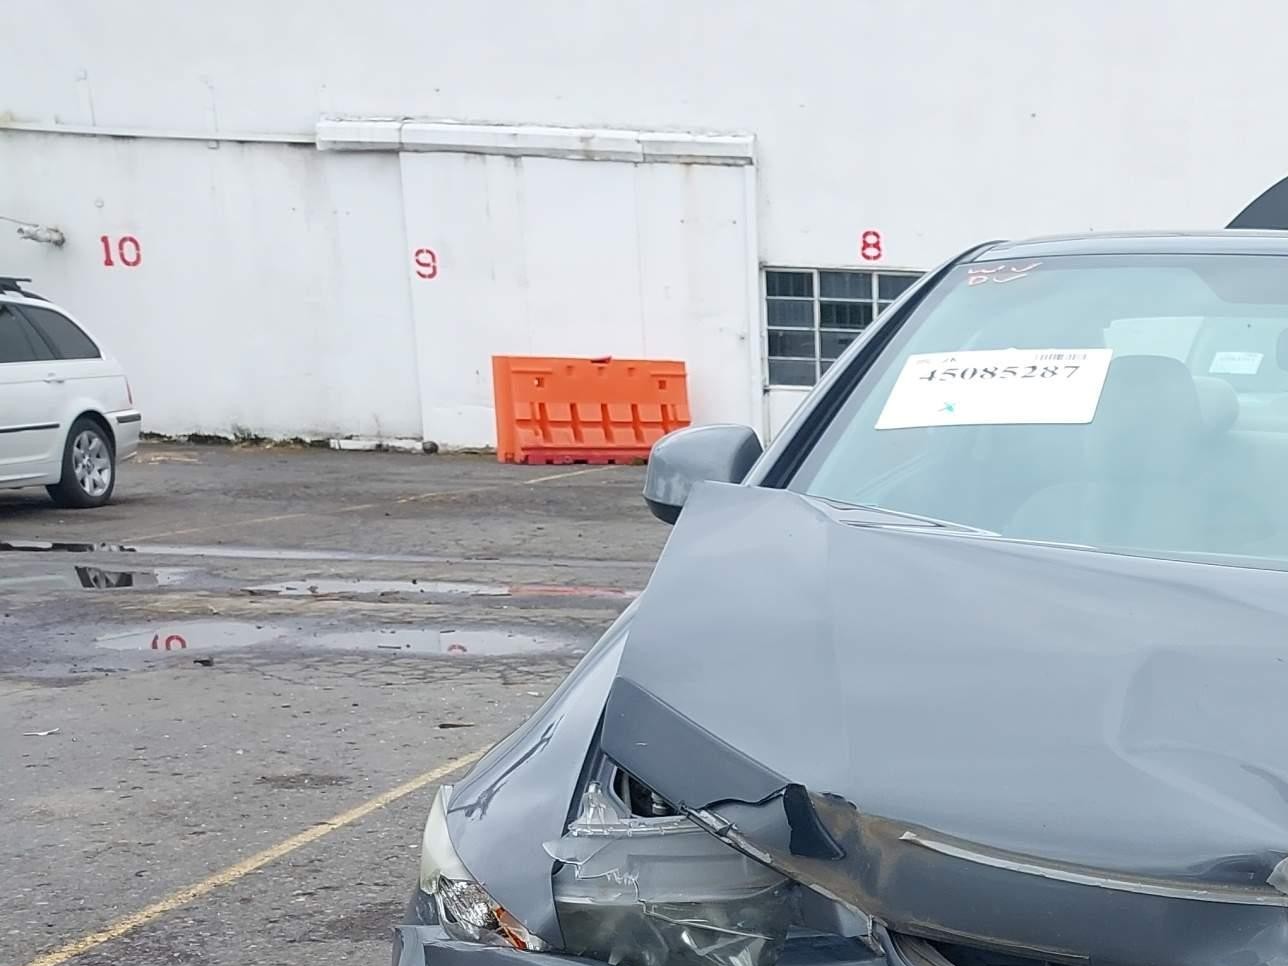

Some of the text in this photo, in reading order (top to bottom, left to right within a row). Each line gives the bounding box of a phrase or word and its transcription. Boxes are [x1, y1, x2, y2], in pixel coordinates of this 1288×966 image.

[100, 235, 142, 268] 10
[860, 230, 882, 261] 8
[416, 248, 438, 279] 9
[919, 364, 1081, 383] 45085287
